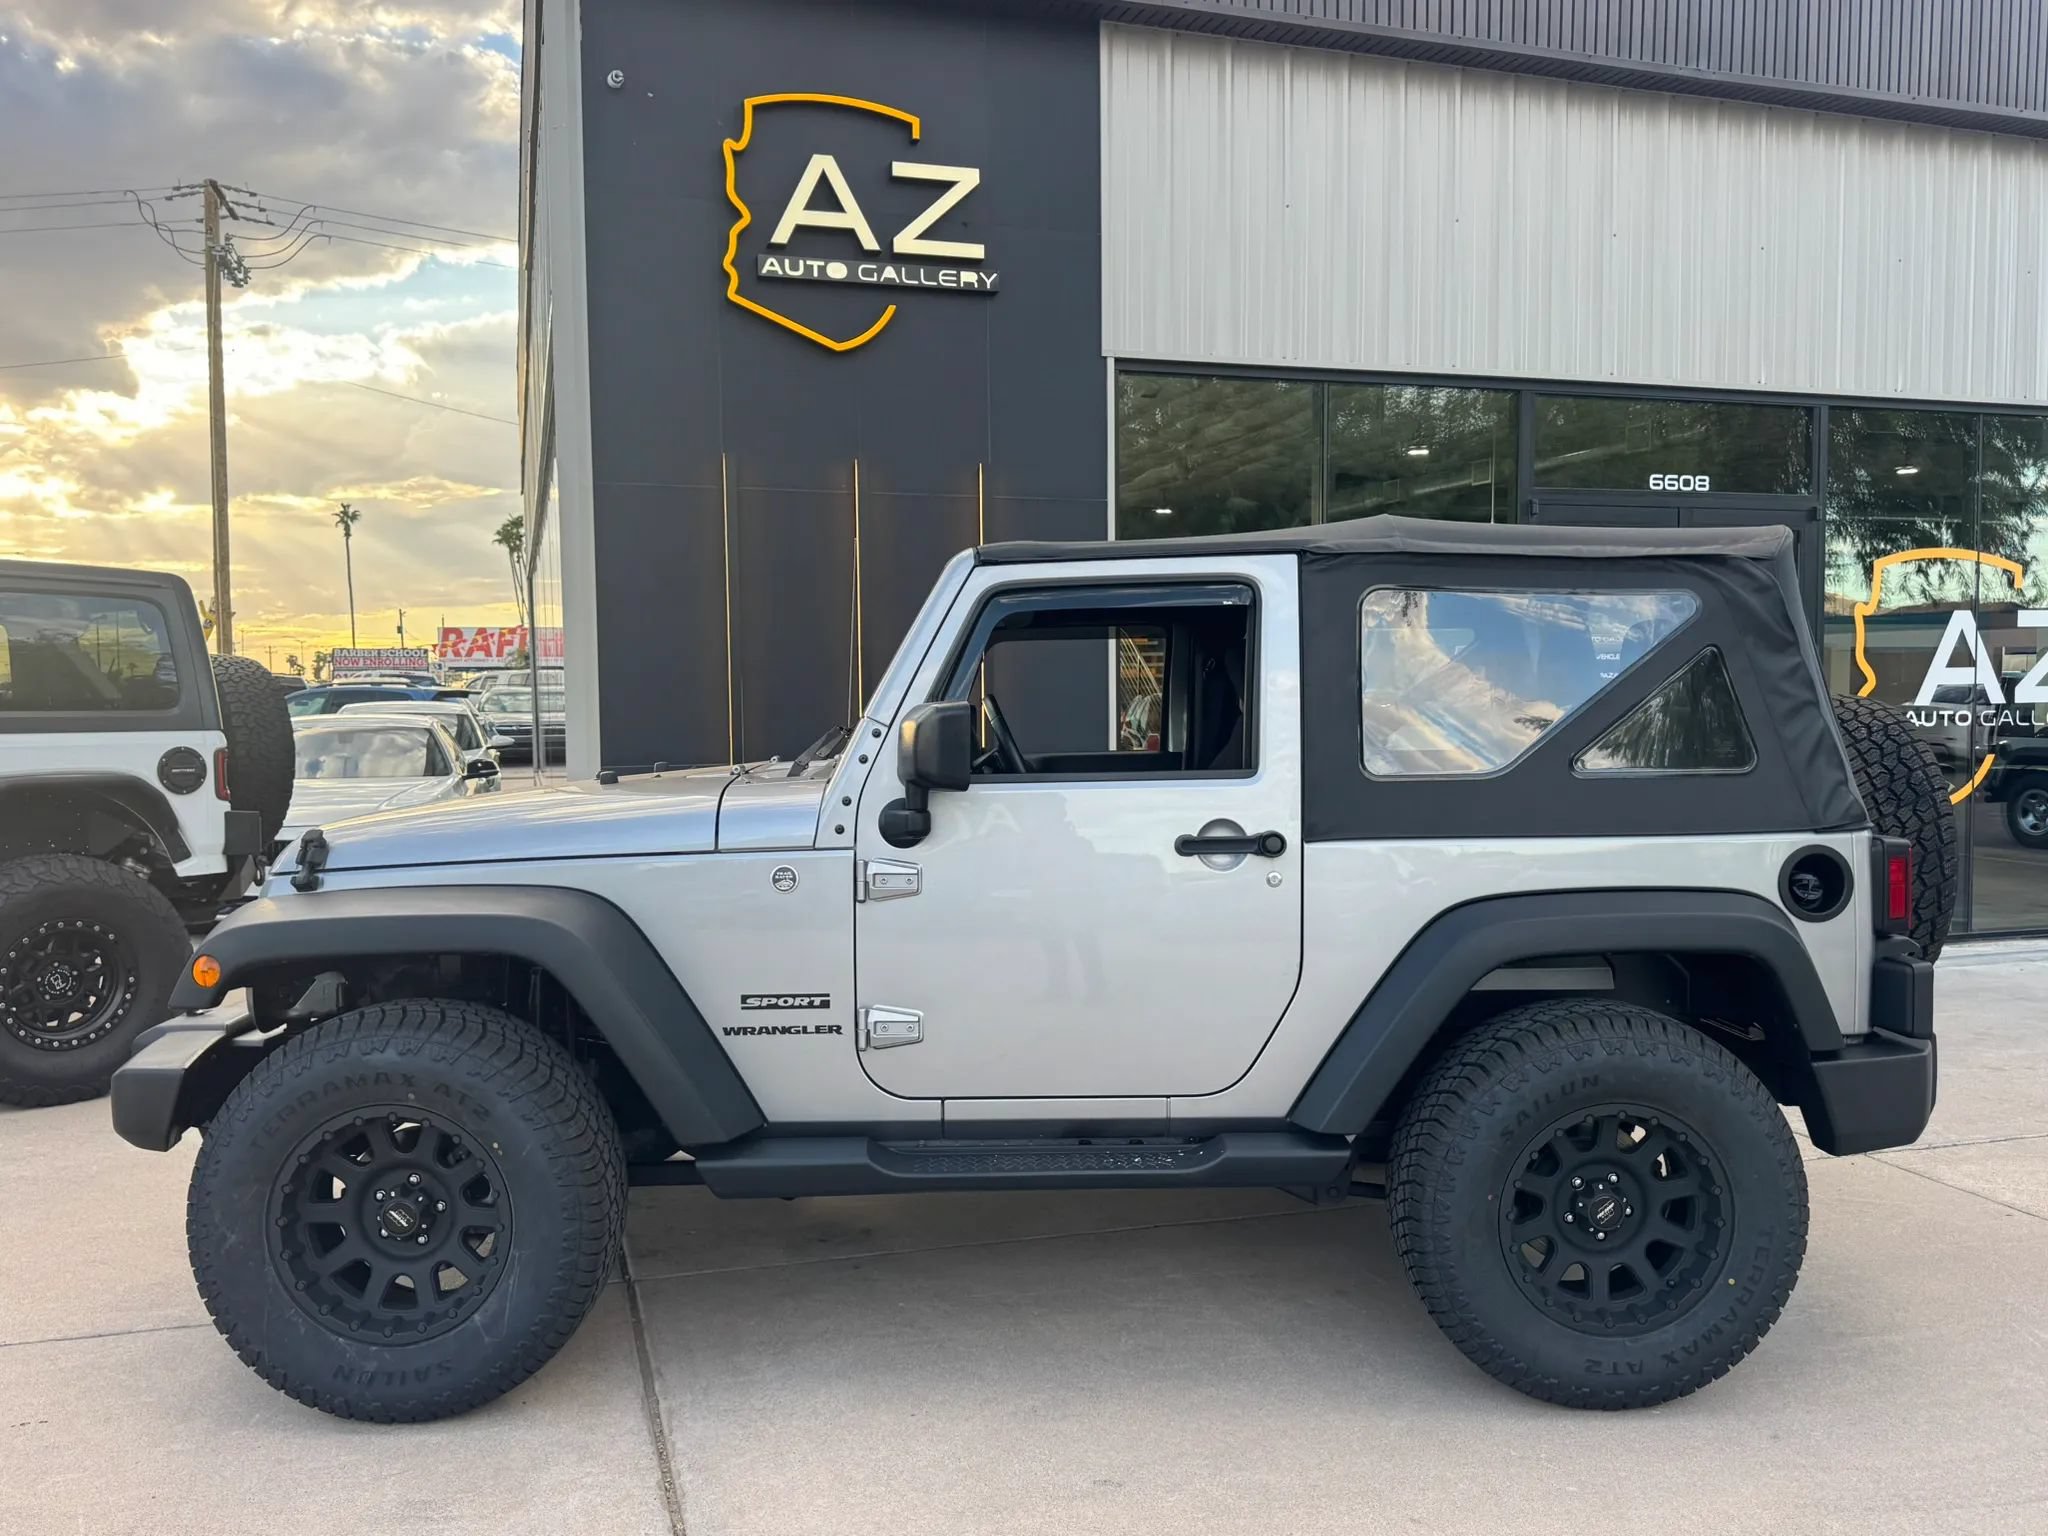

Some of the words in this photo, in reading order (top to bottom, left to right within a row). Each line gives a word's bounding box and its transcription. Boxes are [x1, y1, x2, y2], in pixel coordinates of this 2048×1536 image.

[768, 153, 985, 260] AZ
[761, 256, 849, 280] AUTO
[857, 264, 998, 289] GALLERY
[1649, 473, 1710, 492] 6608
[334, 649, 379, 657] BARBER
[381, 649, 427, 657] SCHOOL
[335, 658, 360, 666] NOW
[1906, 710, 1972, 727] AUTO
[1980, 710, 2048, 726] GALL
[743, 996, 829, 1008] SPORT
[722, 1024, 844, 1036] WRANGLER
[250, 1071, 415, 1150] TERRAMAX
[1500, 1074, 1600, 1144] SAILUN
[1659, 1225, 1774, 1368] TERRAMAX
